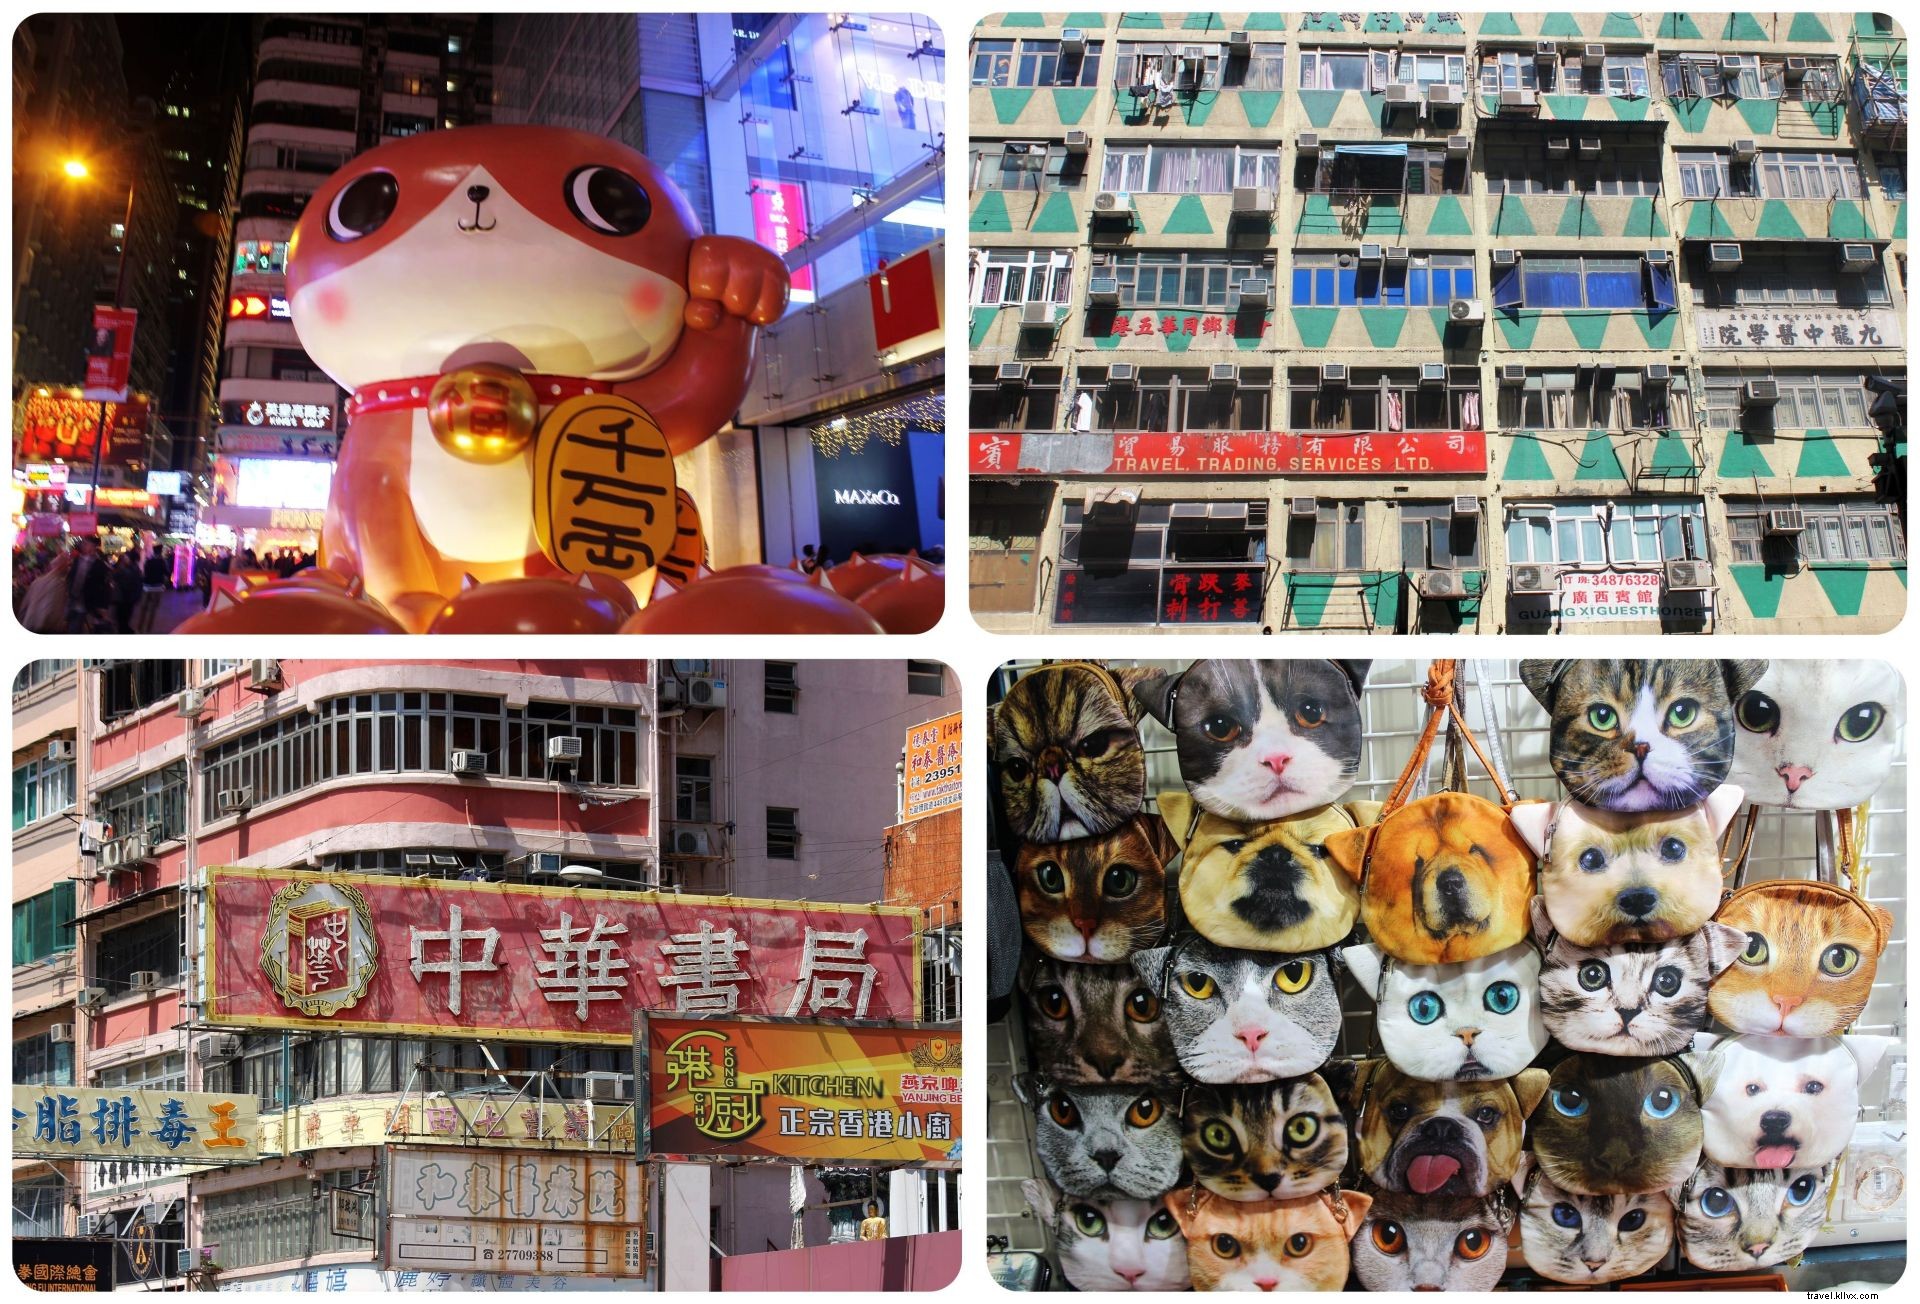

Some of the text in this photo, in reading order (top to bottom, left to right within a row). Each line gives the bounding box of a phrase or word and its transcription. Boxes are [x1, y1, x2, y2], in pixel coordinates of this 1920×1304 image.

[1289, 456, 1382, 471] SERVICES
[1395, 456, 1434, 471] LTD.
[1592, 575, 1659, 586] 34876328
[1573, 590, 1653, 604] 廣西賓館
[409, 903, 878, 1022] 中華書局
[724, 1047, 734, 1088] KONG
[772, 1074, 878, 1097] KITCHEN
[902, 1074, 962, 1092] 燕京啤
[903, 1093, 947, 1103] YANJING
[694, 1093, 705, 1128] CHU
[497, 1249, 554, 1262] 27709388
